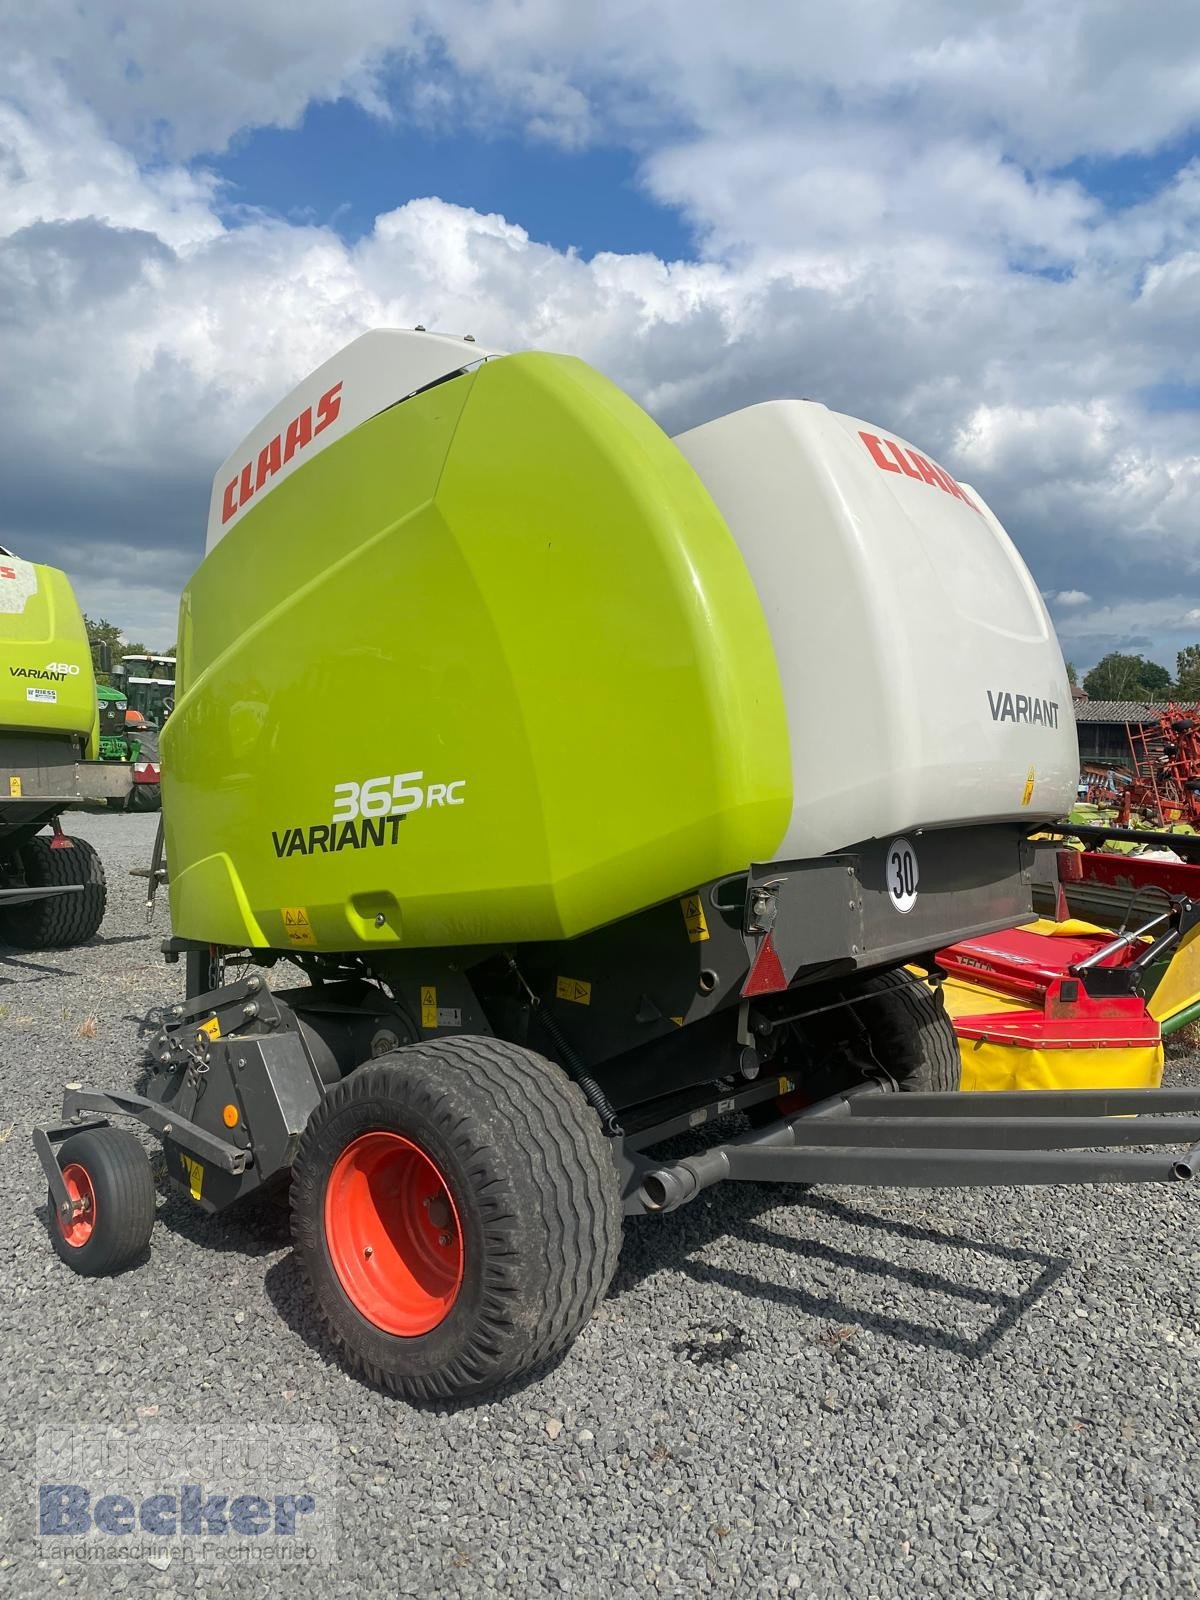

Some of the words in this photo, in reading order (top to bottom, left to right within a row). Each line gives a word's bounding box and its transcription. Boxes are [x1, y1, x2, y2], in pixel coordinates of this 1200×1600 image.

[222, 380, 343, 525] CLAAS
[9, 667, 67, 682] VARIANT
[46, 662, 80, 675] 480
[987, 690, 1059, 729] VARIANT
[332, 770, 424, 823] 365
[426, 780, 467, 808] RC
[271, 813, 407, 859] VARIANT
[891, 850, 914, 899] 30
